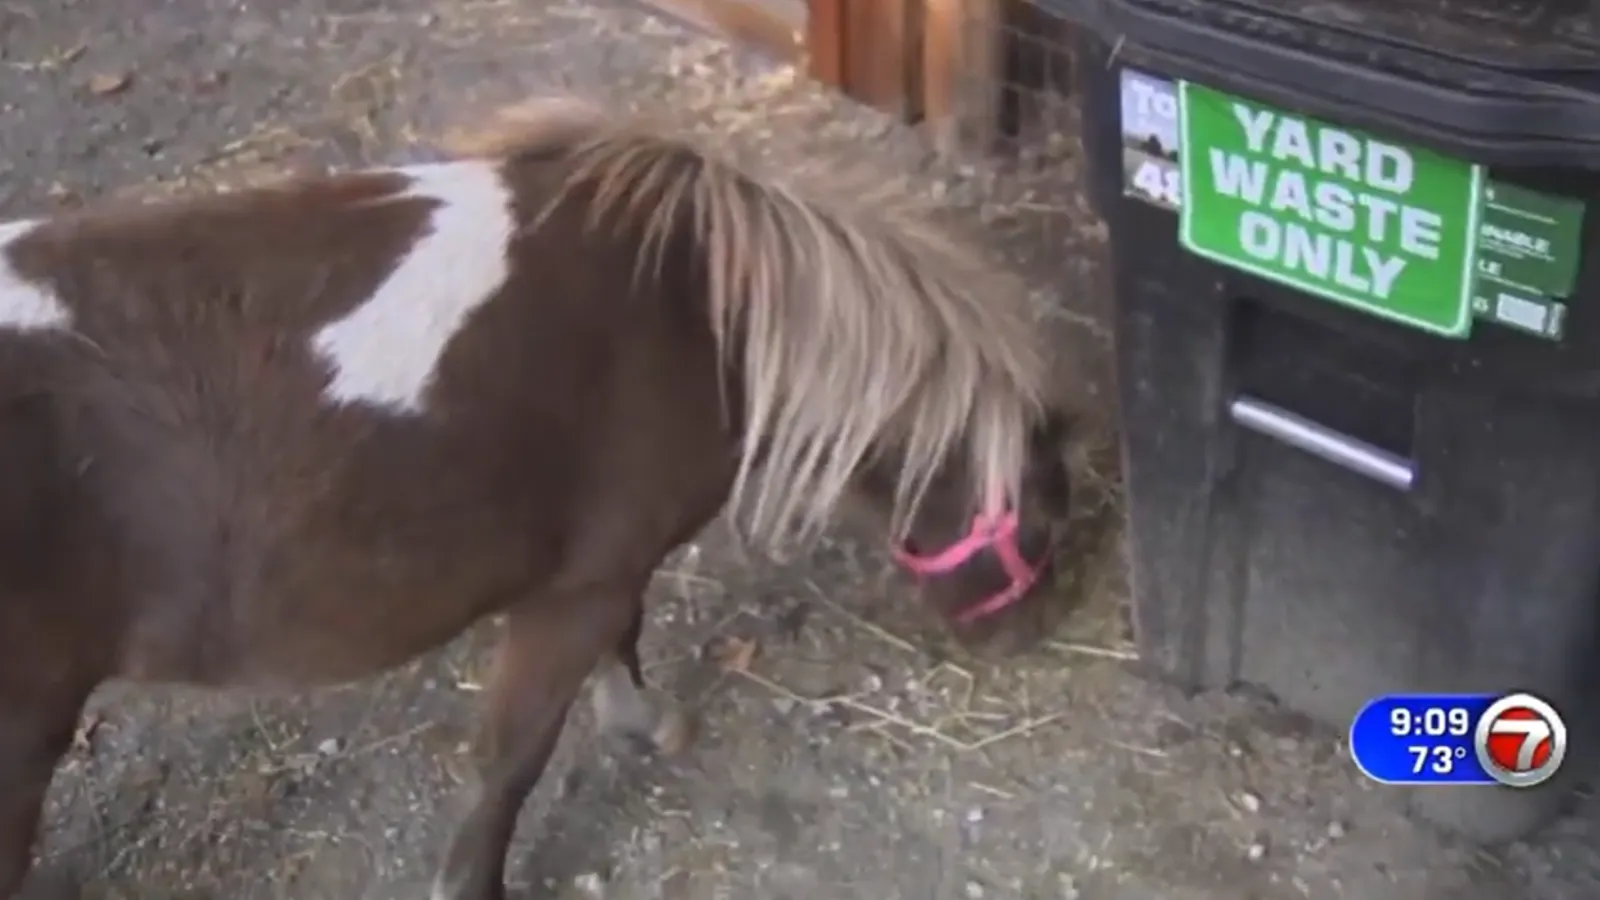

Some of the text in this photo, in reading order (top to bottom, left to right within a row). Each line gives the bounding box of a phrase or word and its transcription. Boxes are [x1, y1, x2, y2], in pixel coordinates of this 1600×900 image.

[1232, 102, 1414, 194] YARD
[1209, 146, 1442, 260] WASTE
[1239, 211, 1407, 299] ONLY
